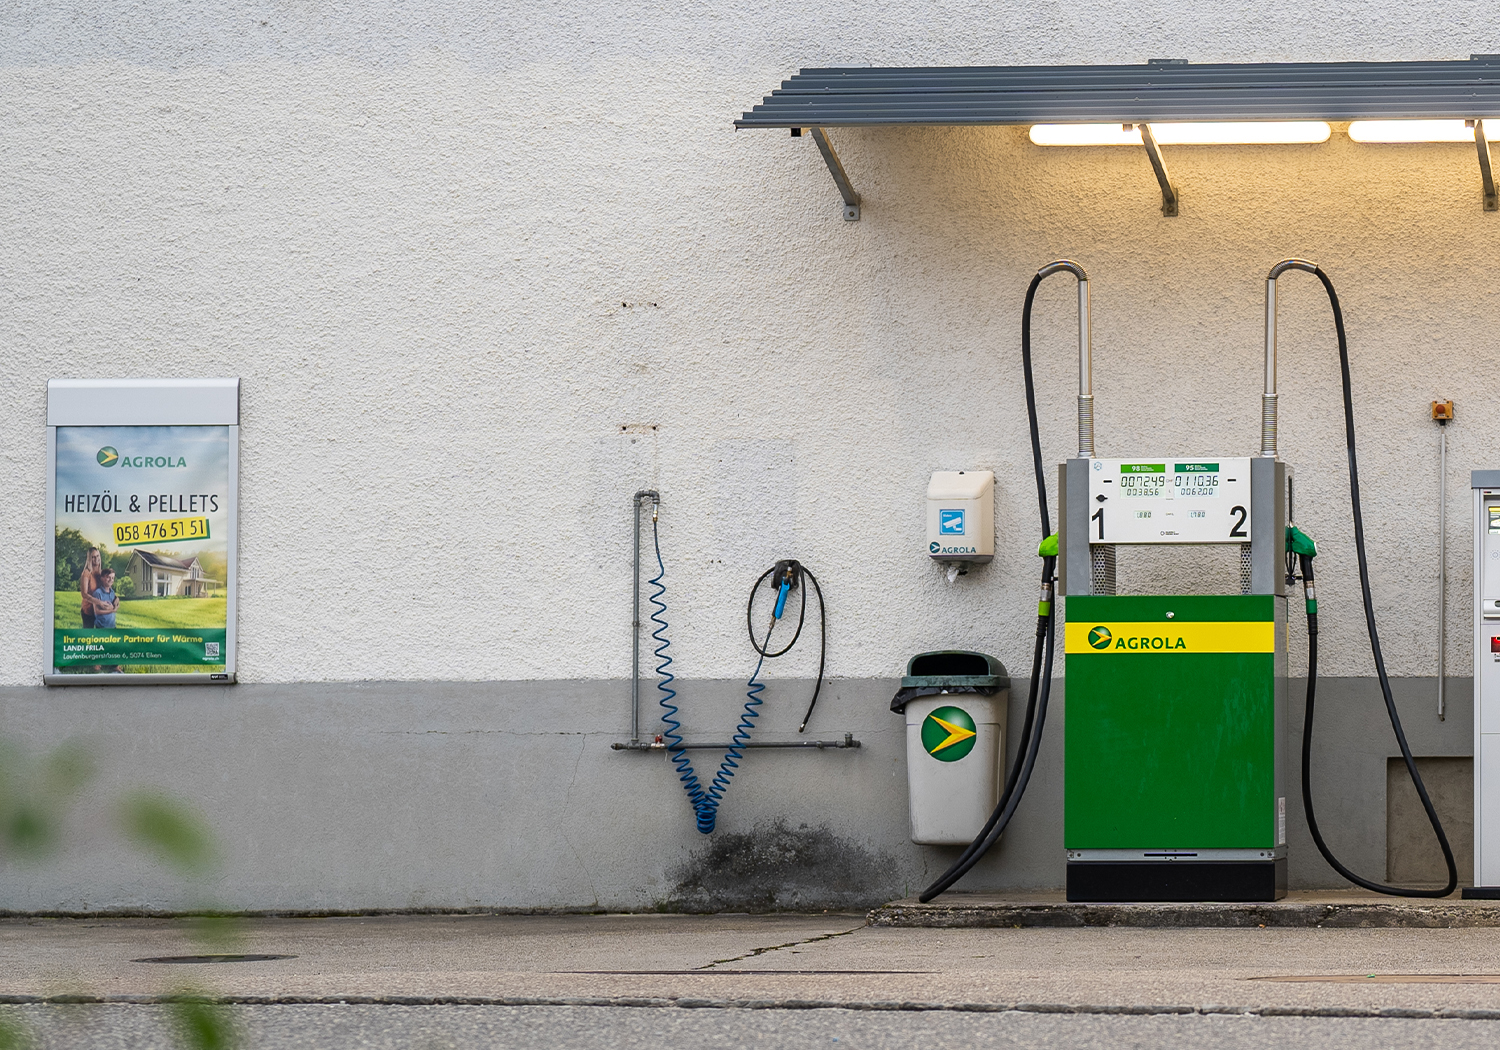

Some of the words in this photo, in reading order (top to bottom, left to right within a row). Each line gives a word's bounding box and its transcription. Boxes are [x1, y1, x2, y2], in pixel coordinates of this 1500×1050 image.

[121, 456, 187, 468] AGROLA
[65, 490, 122, 512] HEIZÖL
[129, 494, 140, 513] &
[149, 494, 219, 513] PELLETS
[116, 525, 140, 542] 058
[144, 523, 167, 539] 476
[170, 522, 184, 536] 51
[190, 520, 204, 535] 51
[1092, 508, 1104, 540] 1
[1229, 505, 1247, 537] 2
[78, 636, 121, 644] regionaler
[157, 635, 170, 643] für
[1115, 637, 1186, 649] AGROLA
